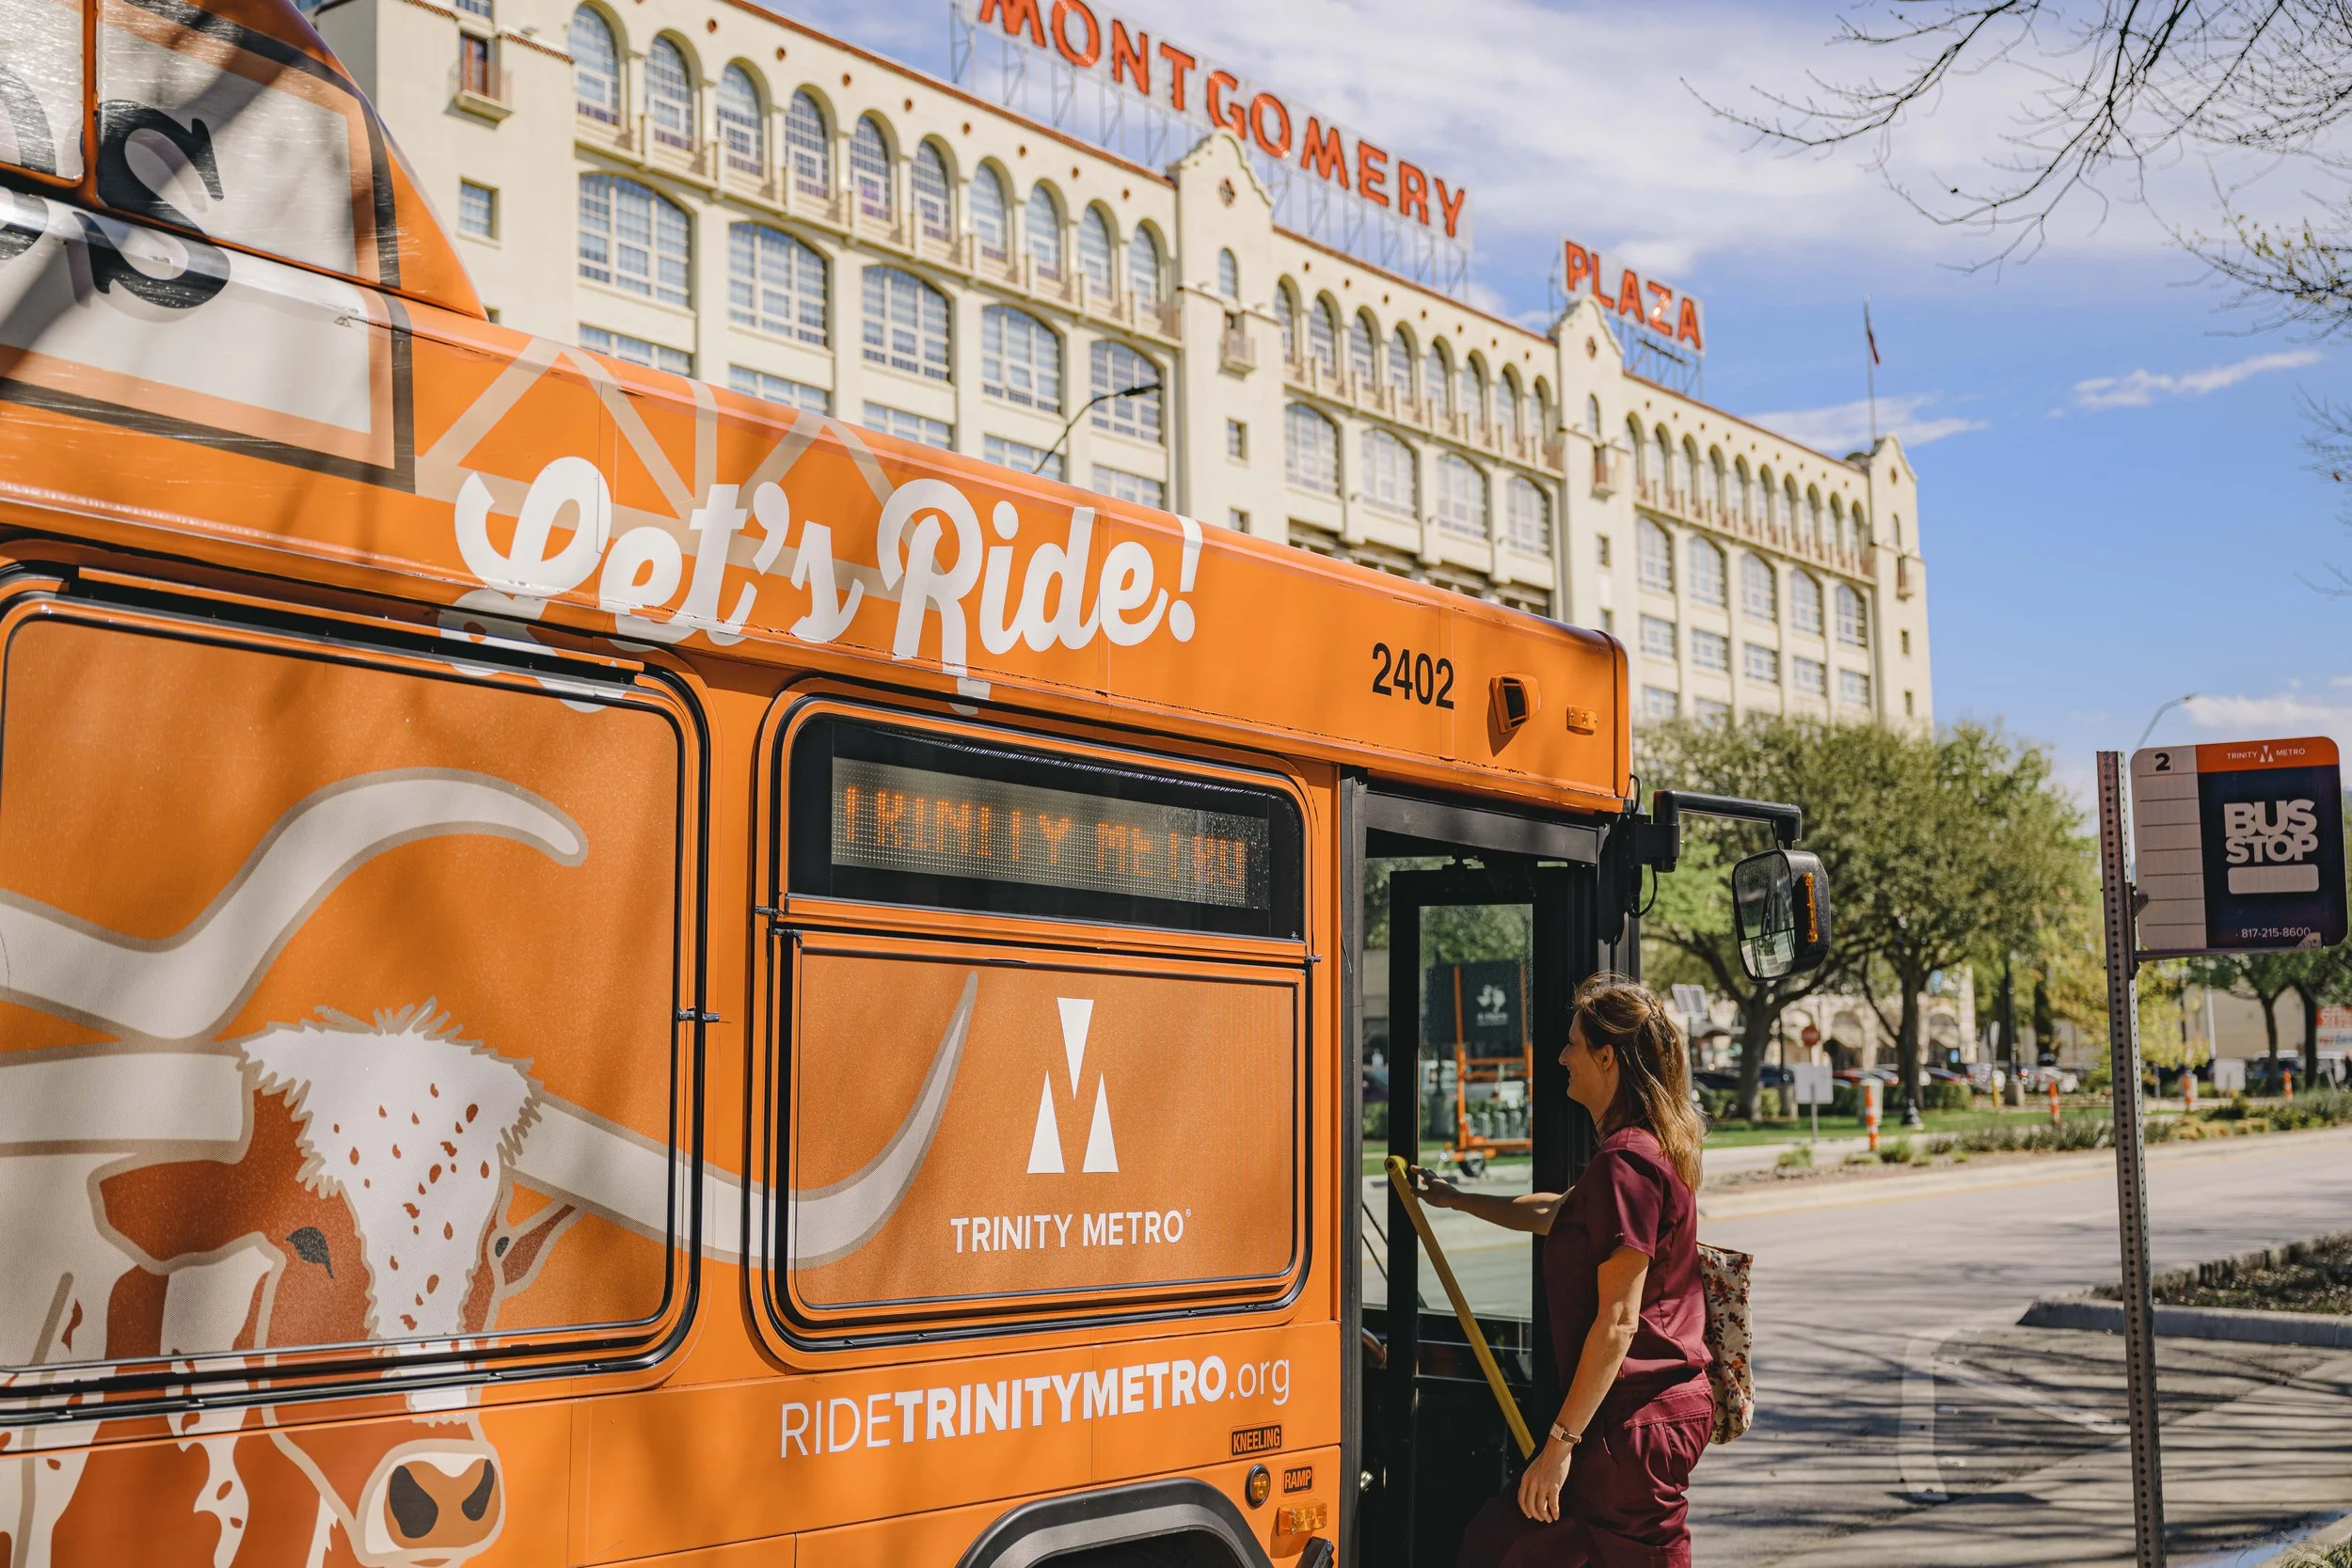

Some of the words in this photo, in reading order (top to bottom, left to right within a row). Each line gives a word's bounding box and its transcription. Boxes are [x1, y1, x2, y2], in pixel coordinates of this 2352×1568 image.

[979, 0, 1467, 239] MONTGOMERY
[1564, 239, 1704, 350] PLAZA
[877, 478, 1203, 715] Ride!
[1372, 641, 1454, 710] 2402
[2154, 752, 2171, 772] 2
[2227, 751, 2258, 760] TRINITY
[2276, 748, 2306, 757] METRO
[2223, 799, 2317, 837] BUS
[2225, 832, 2318, 864] STOP
[2241, 927, 2312, 939] 817-215-8600
[950, 1213, 1073, 1254] TRINITY
[780, 1354, 1291, 1459] RIDETRINITYMETRO.org
[1232, 1428, 1280, 1453] KNEELING
[1284, 1469, 1311, 1490] RAMP
